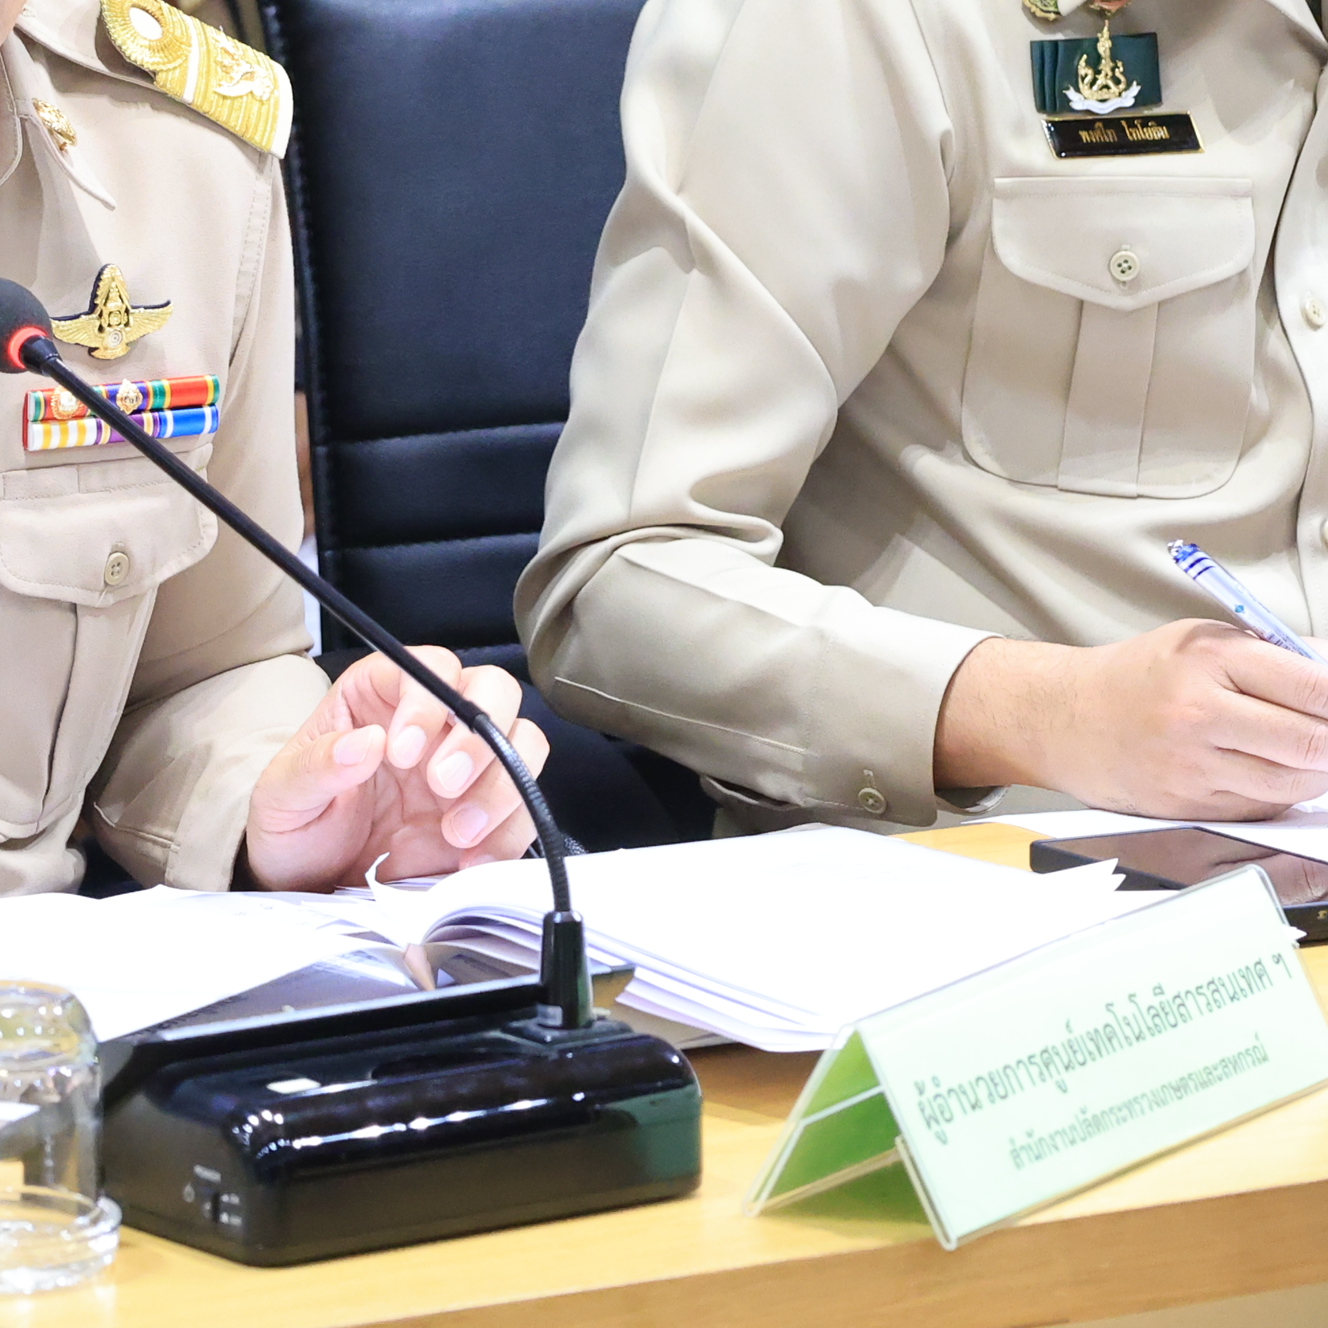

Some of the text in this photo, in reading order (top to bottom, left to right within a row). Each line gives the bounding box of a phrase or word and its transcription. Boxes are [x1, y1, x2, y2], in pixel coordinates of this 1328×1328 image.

[913, 958, 1274, 1145] ผู้อำนวยการศูนย์เทคโนโลยีสารสนเทศ
